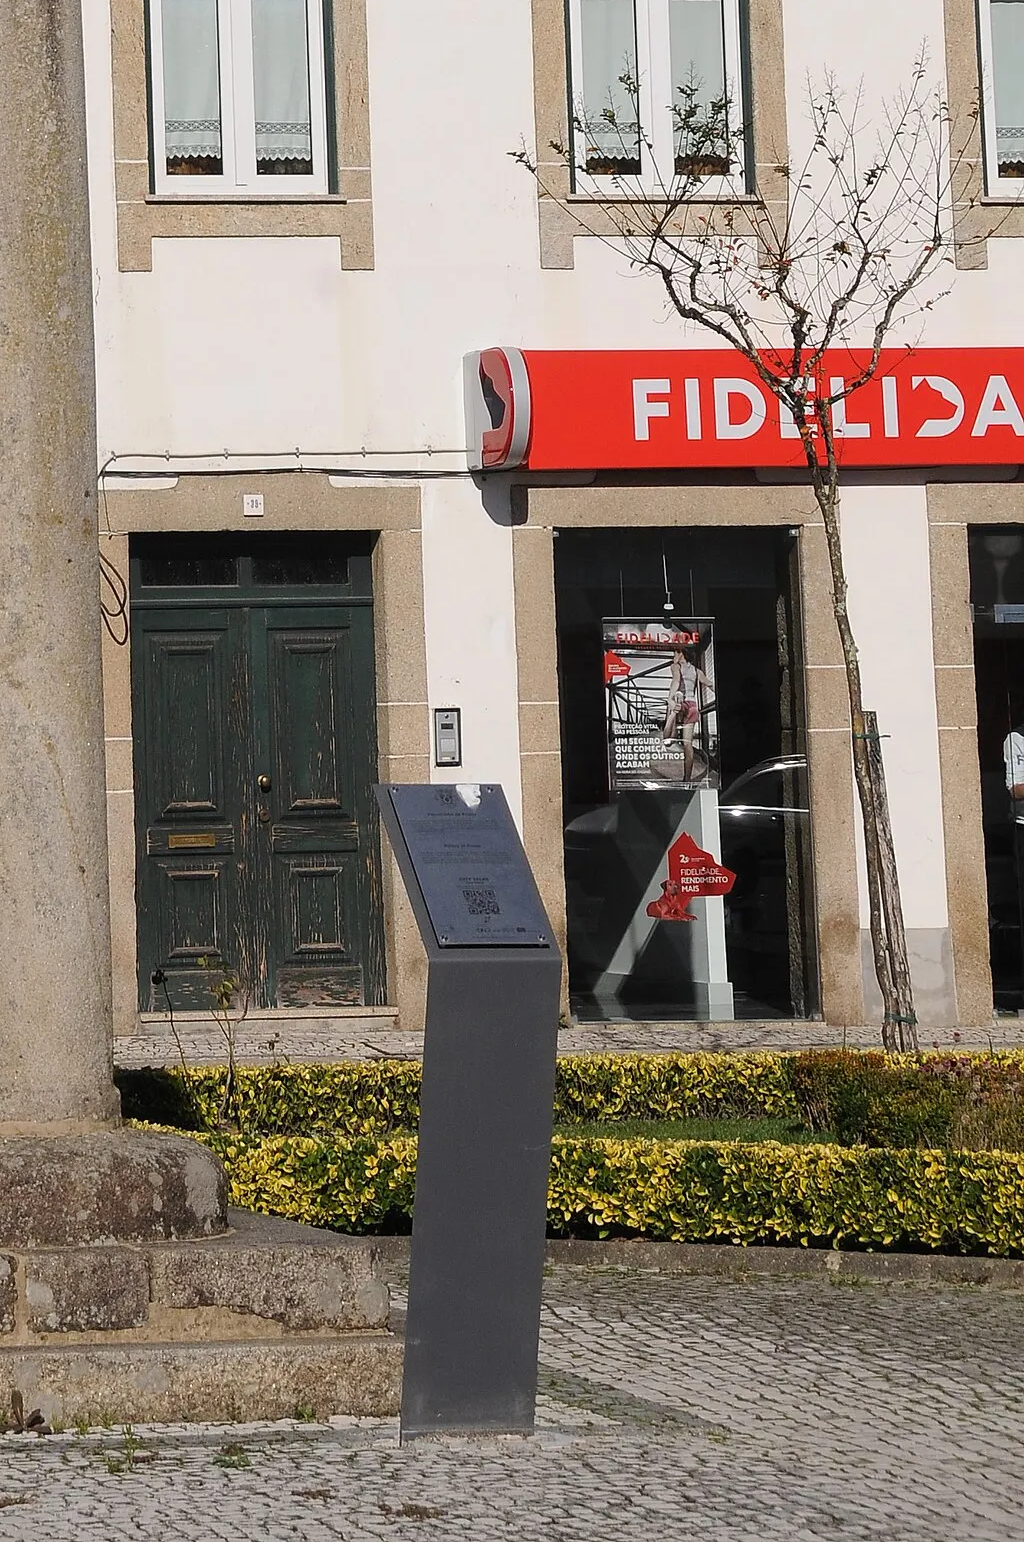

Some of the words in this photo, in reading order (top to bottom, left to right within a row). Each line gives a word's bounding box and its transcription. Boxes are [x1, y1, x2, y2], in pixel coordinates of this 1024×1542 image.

[616, 632, 700, 645] FIDELIDADE
[615, 737, 628, 745] UM
[628, 737, 661, 745] SEGURO
[633, 745, 667, 753] COMEÇA
[651, 752, 685, 760] OUTROS
[680, 868, 722, 876] FIDELIDADE
[680, 876, 729, 884] RENDIMENTO
